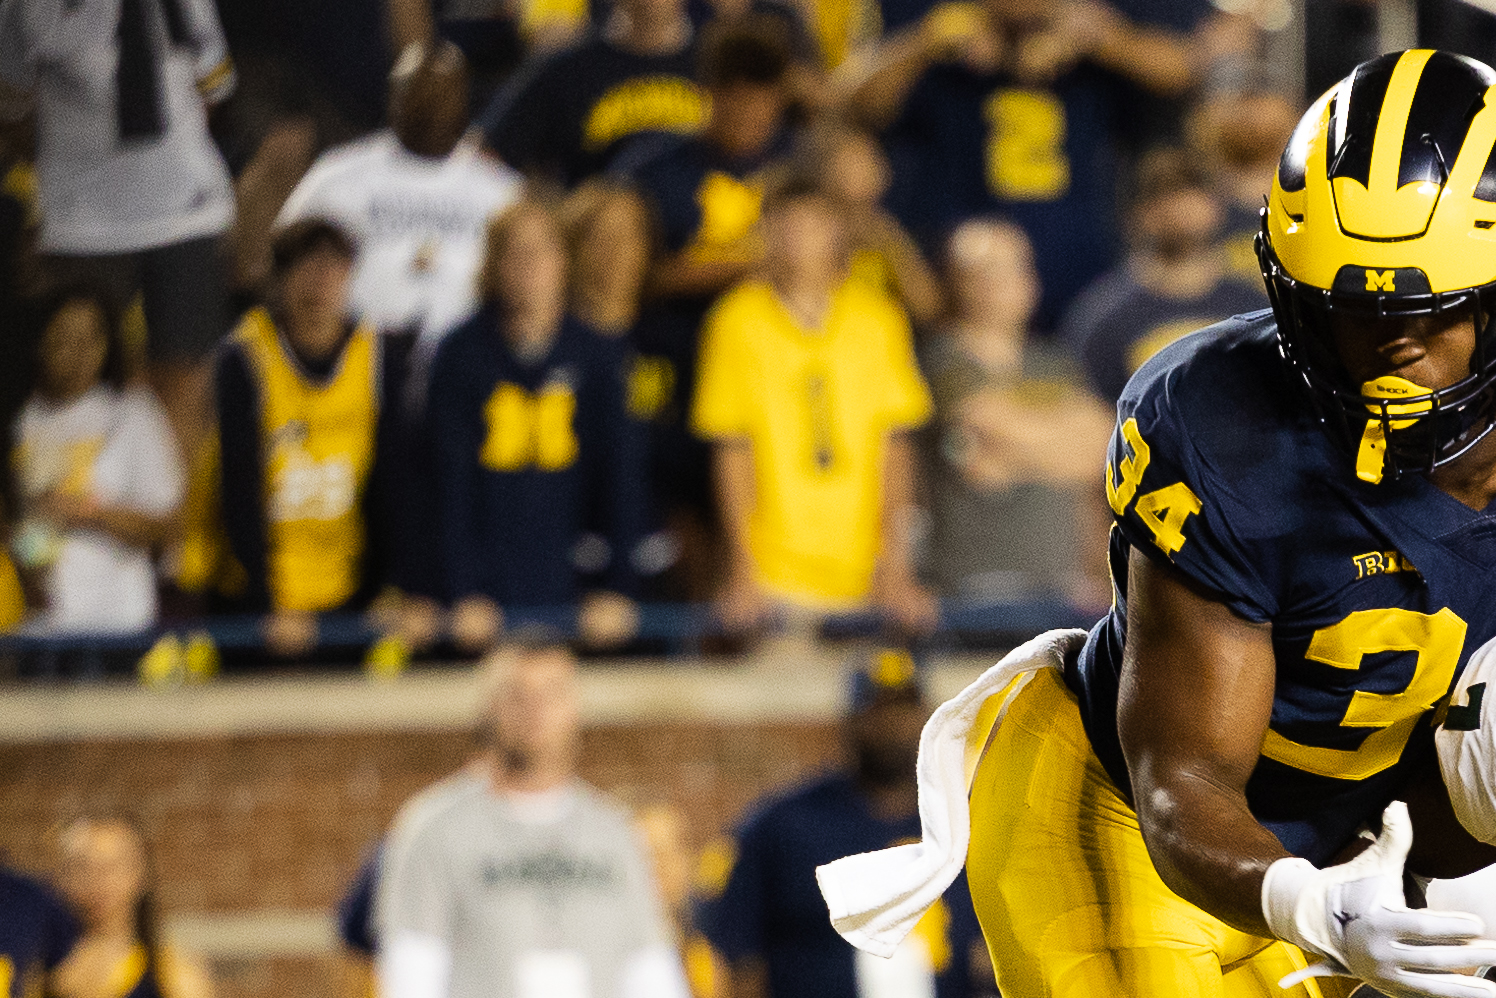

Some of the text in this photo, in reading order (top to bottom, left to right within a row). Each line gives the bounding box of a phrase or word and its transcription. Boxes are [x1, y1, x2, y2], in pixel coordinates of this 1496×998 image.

[1365, 269, 1396, 292] M
[478, 380, 580, 472] M
[1106, 417, 1203, 556] 34
